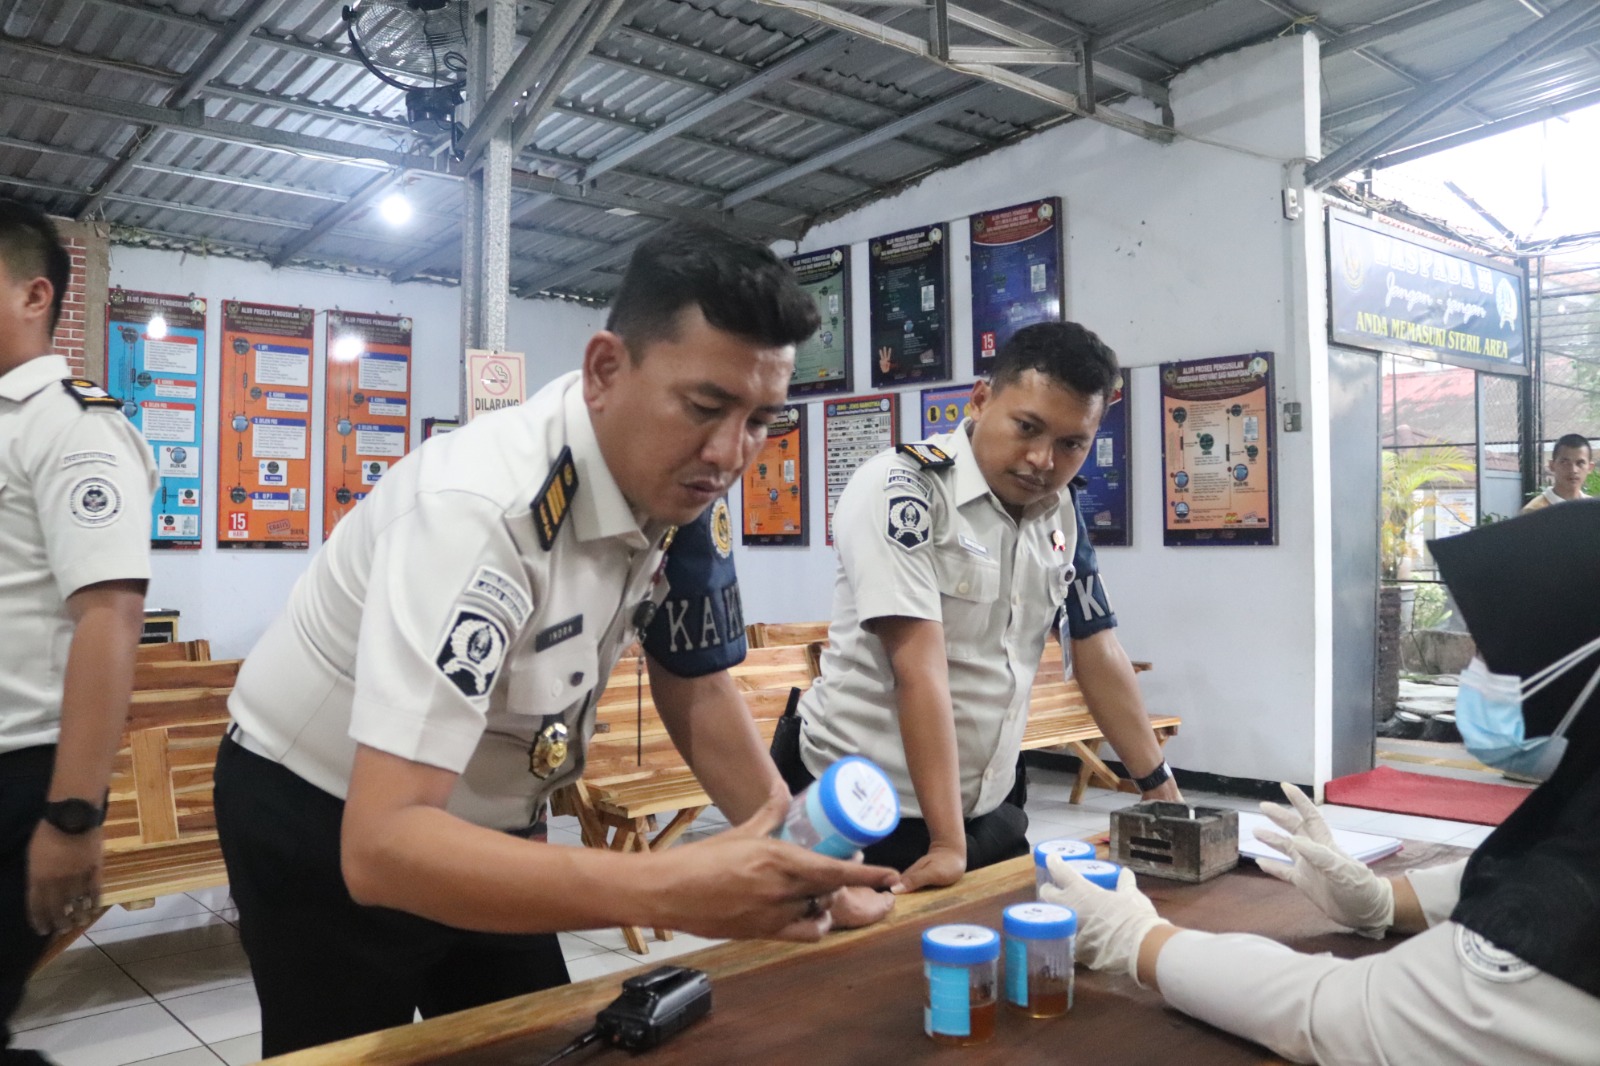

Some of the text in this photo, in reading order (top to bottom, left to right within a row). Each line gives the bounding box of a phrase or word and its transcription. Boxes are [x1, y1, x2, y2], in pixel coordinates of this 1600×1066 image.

[983, 334, 993, 349] 15
[1356, 311, 1508, 359] ANDA MEMASUKI STERIL AREA
[230, 513, 246, 530] 15
